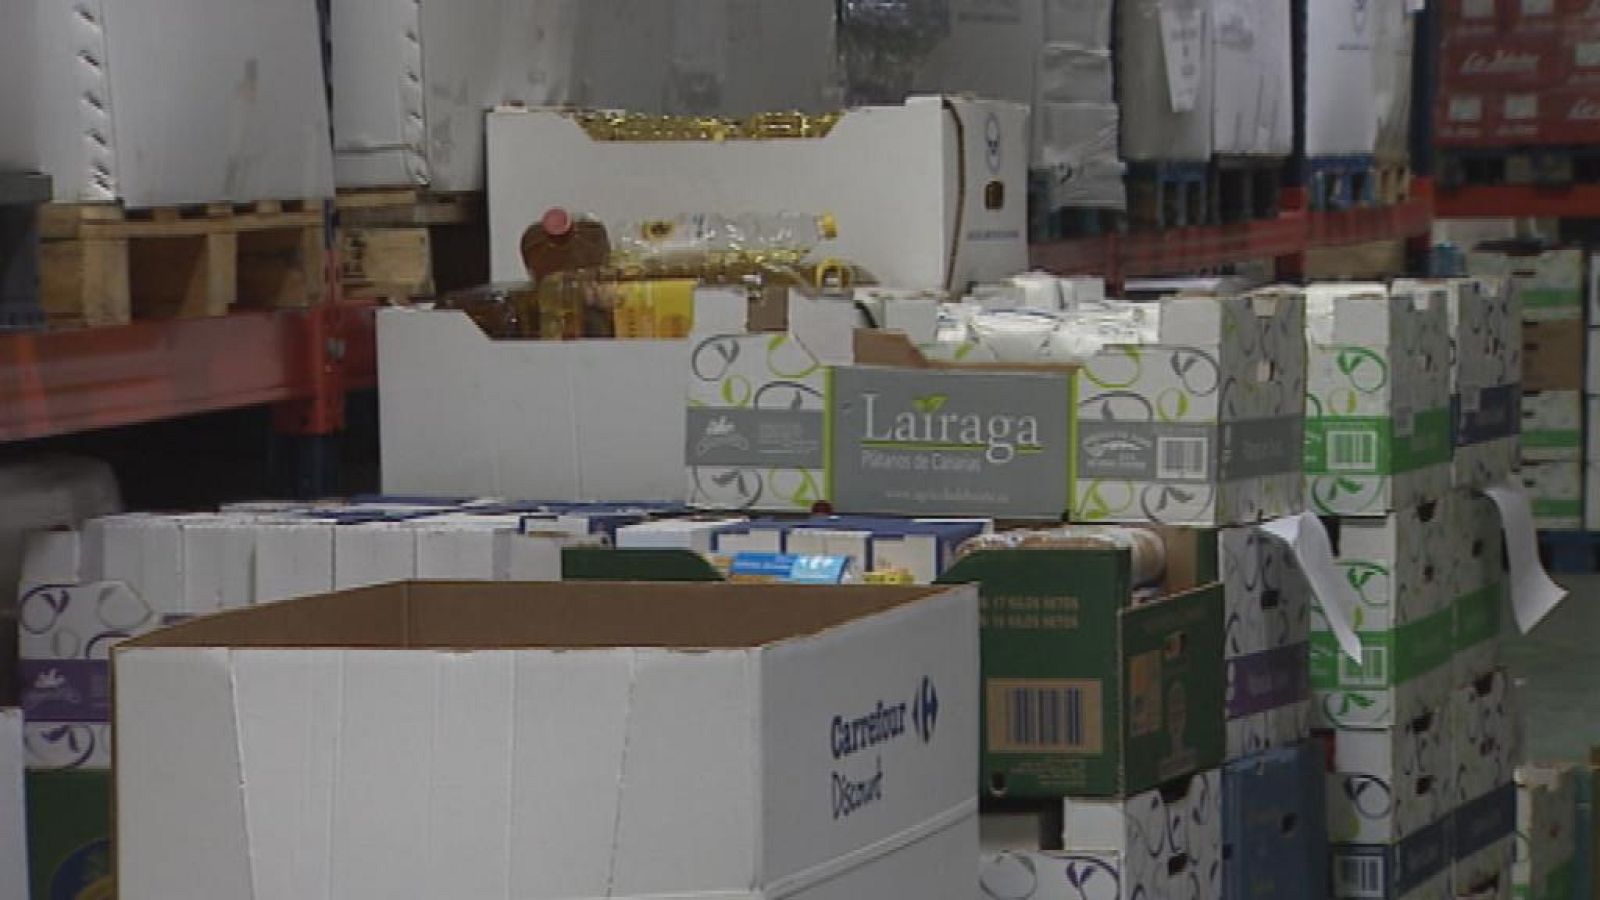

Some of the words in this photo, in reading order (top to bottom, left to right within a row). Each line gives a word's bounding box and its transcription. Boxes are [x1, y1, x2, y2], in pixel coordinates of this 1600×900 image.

[861, 393, 1038, 463] Lairaga
[830, 700, 906, 760] Carrefour
[831, 755, 883, 821] Discount
